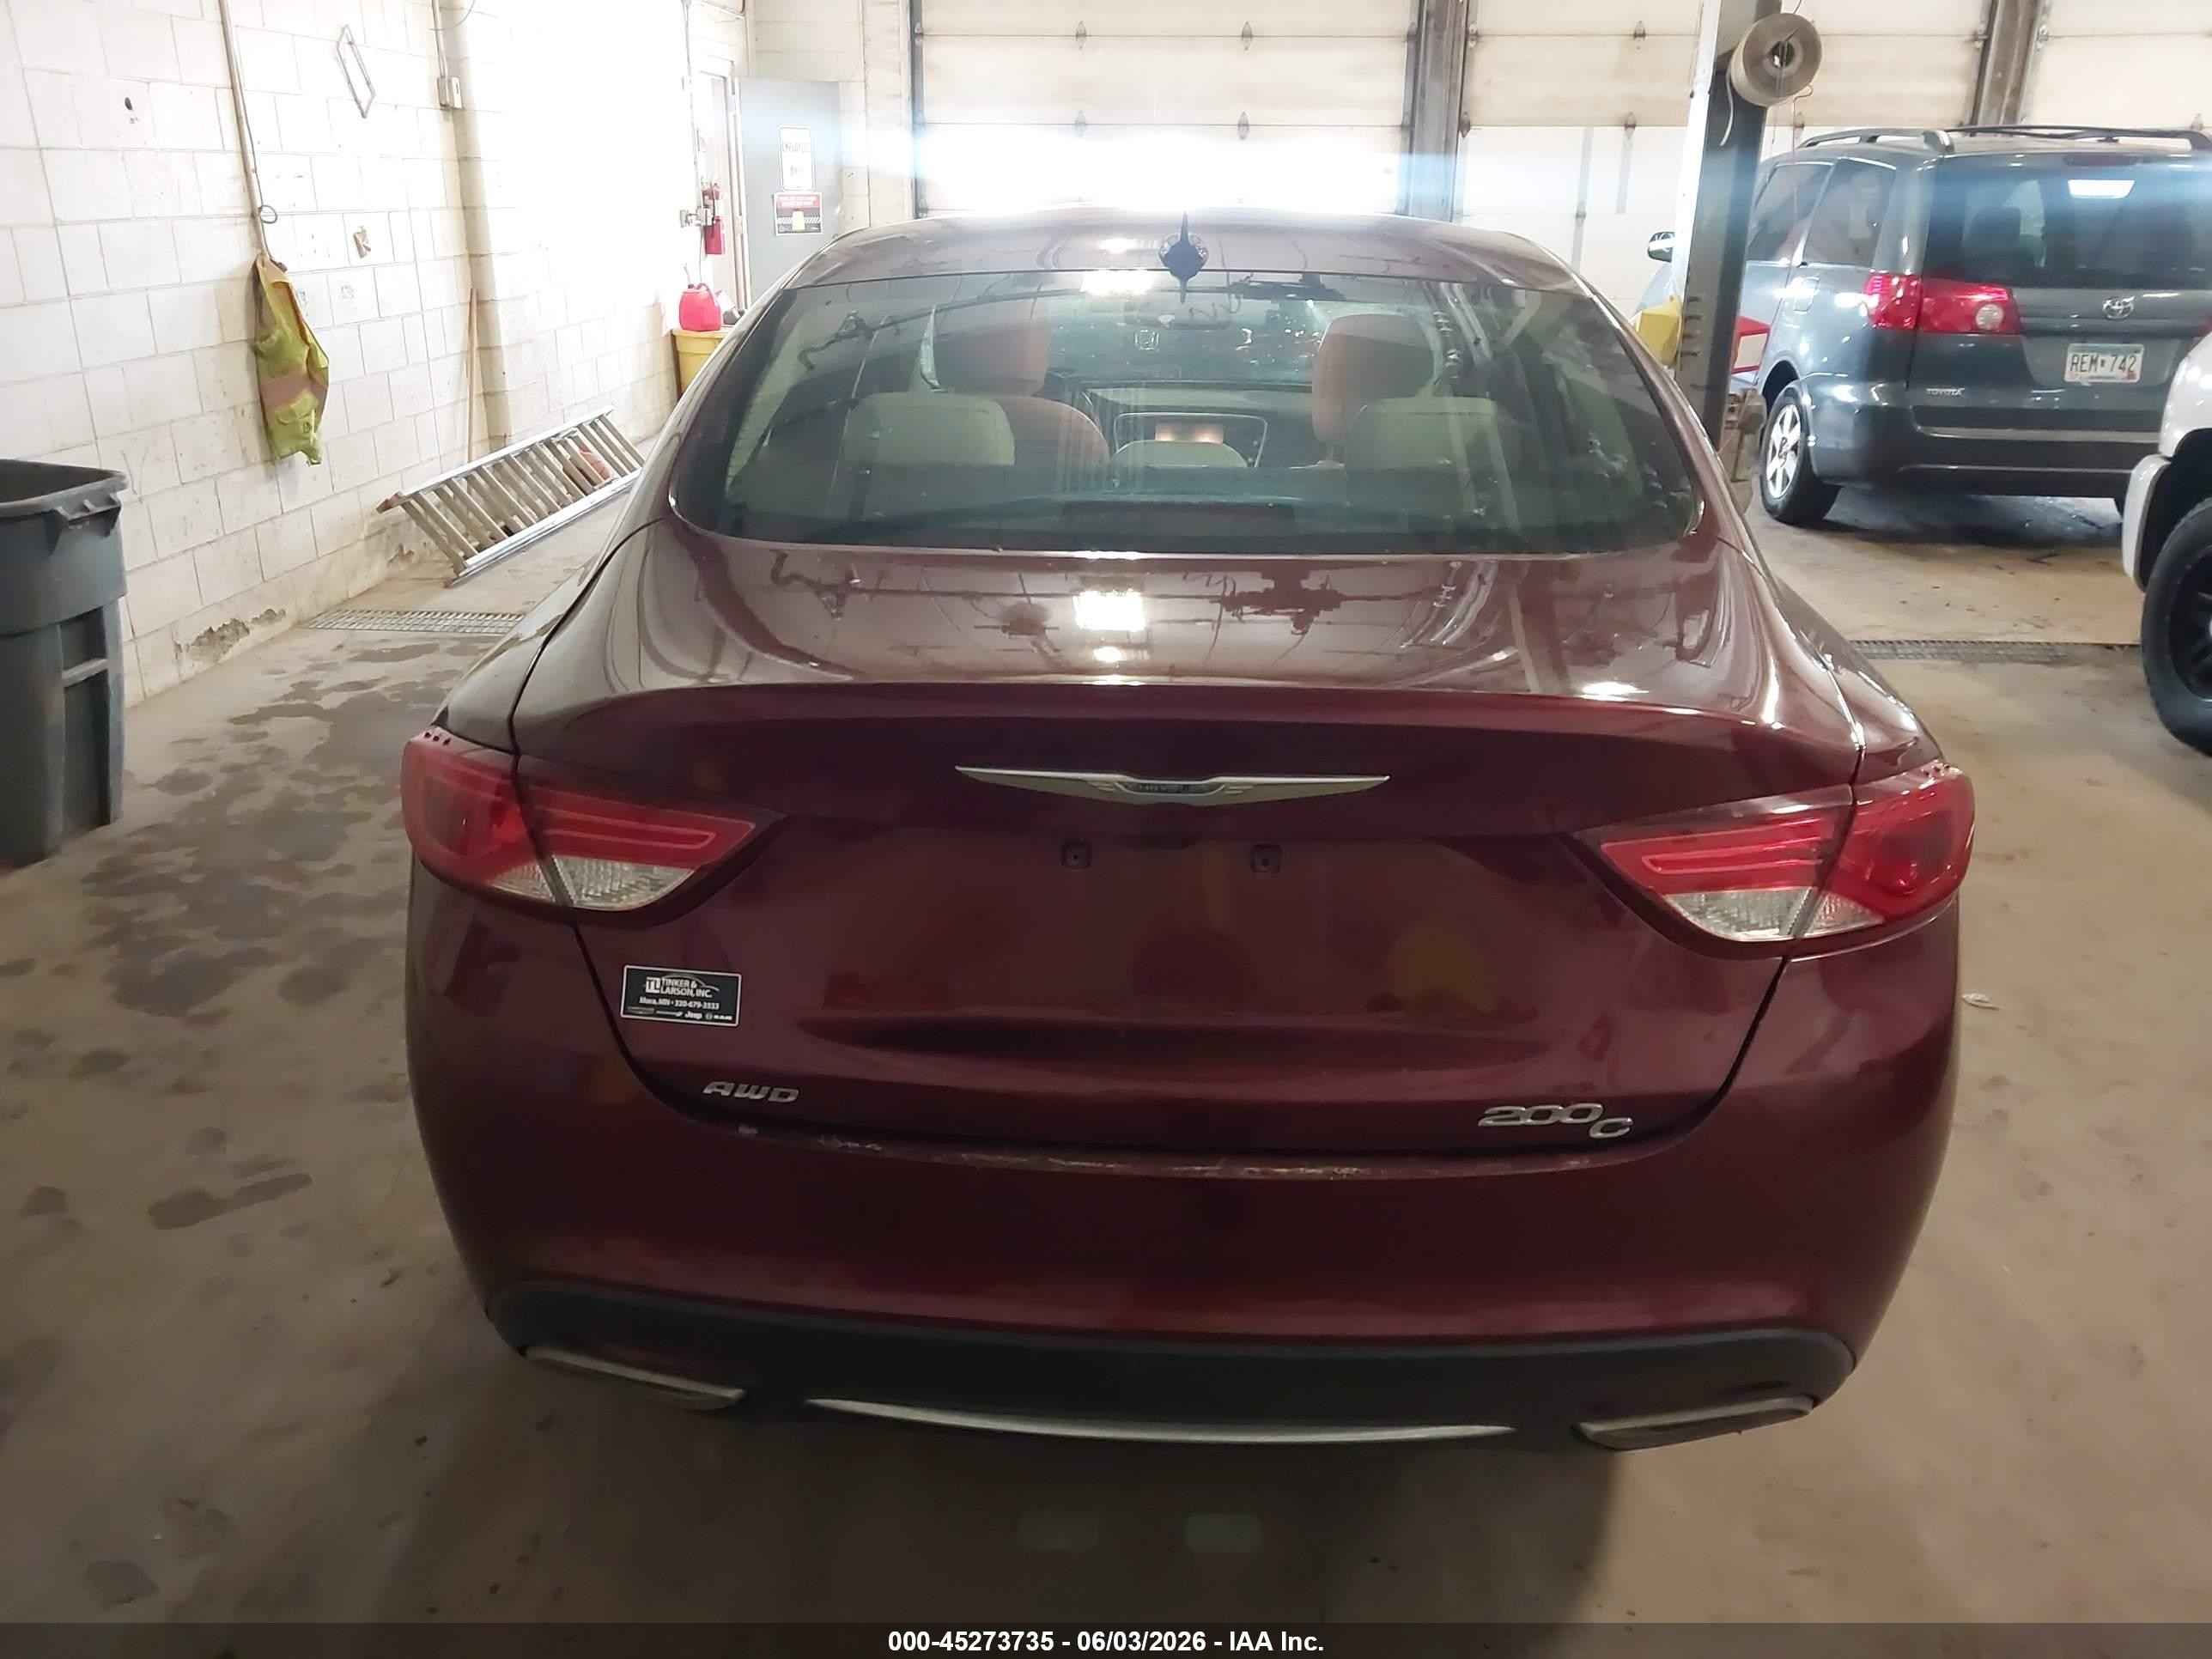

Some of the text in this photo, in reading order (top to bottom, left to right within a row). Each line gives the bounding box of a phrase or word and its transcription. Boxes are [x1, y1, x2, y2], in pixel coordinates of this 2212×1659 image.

[2110, 354, 2136, 373] 742
[1926, 387, 1966, 396] TOYOTA
[661, 977, 690, 988] TINKER
[702, 1081, 799, 1103] AWD
